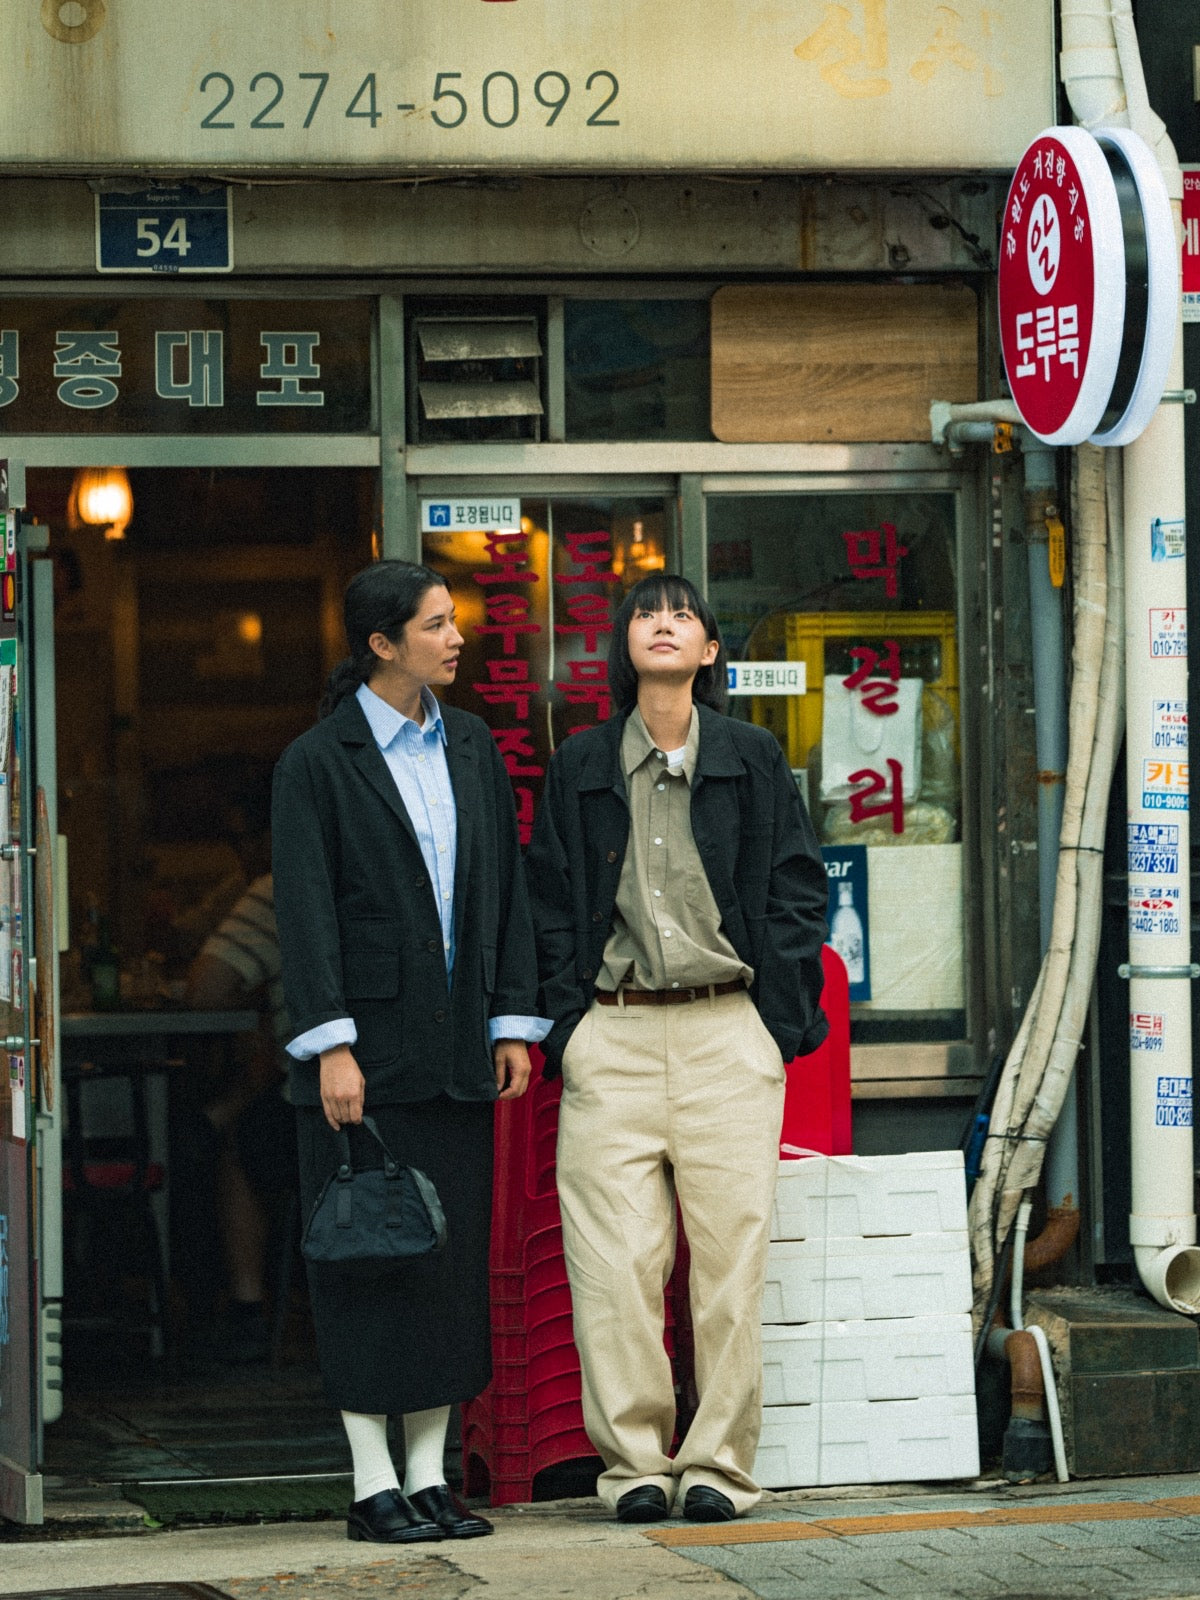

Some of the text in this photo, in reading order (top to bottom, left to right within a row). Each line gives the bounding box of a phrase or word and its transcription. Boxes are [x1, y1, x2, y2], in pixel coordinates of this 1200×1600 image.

[199, 70, 620, 129] 2274-5092
[1033, 149, 1066, 188] 거진항
[136, 218, 192, 257] 54
[1031, 199, 1055, 282] 알
[1015, 304, 1080, 383] 도루묵
[455, 505, 514, 525] 포장됩니다
[554, 530, 621, 735] 도루묵
[742, 668, 799, 688] 포장됩니다
[842, 521, 909, 836] 막걸리
